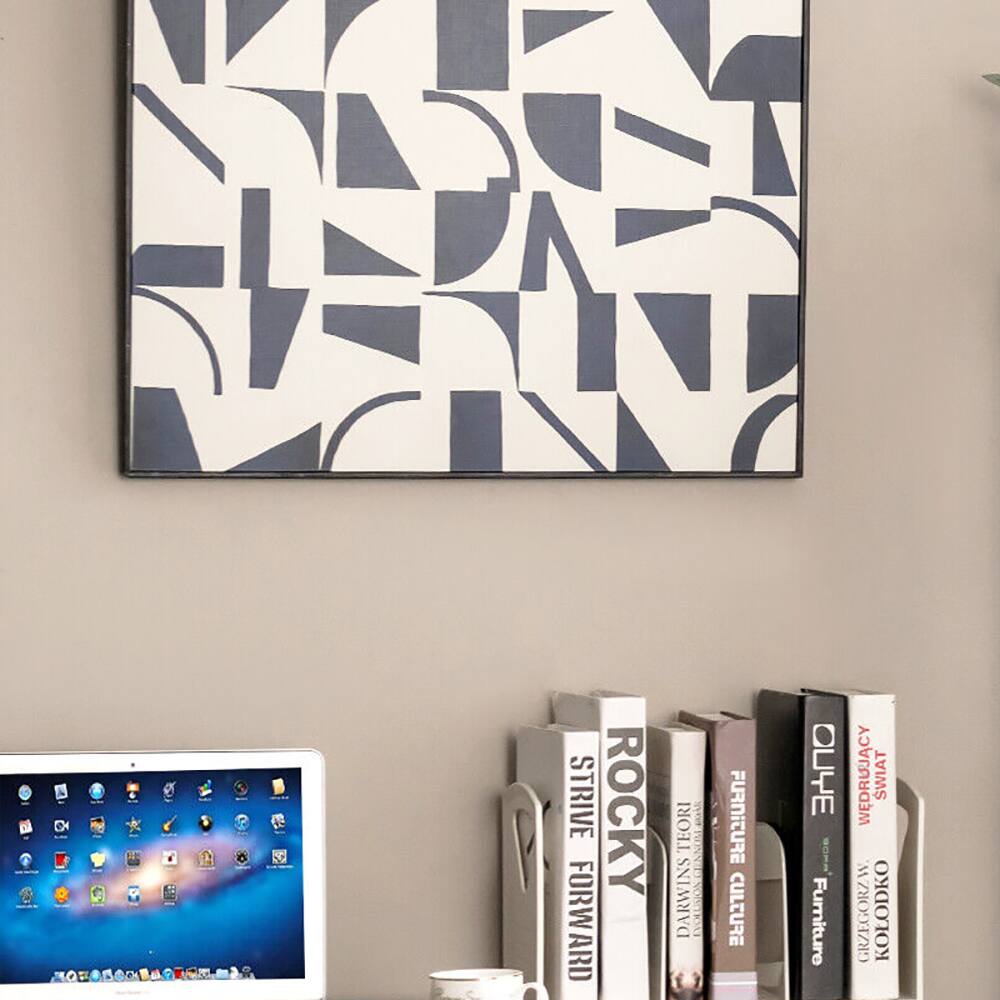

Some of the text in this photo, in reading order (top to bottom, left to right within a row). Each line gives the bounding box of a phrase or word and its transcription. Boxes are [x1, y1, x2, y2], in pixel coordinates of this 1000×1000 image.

[607, 727, 646, 896] ROCKY
[857, 725, 872, 826] WĘDRUJĄCY
[874, 750, 887, 800] ŚWIAT
[568, 756, 595, 982] STRIVE FORWARD
[676, 802, 691, 939] DARWINS TEORI
[728, 871, 745, 947] CULTURE
[874, 860, 890, 961] KOŁODKO
[811, 877, 828, 966] Furniture
[857, 882, 870, 963] GRZEGORZ
